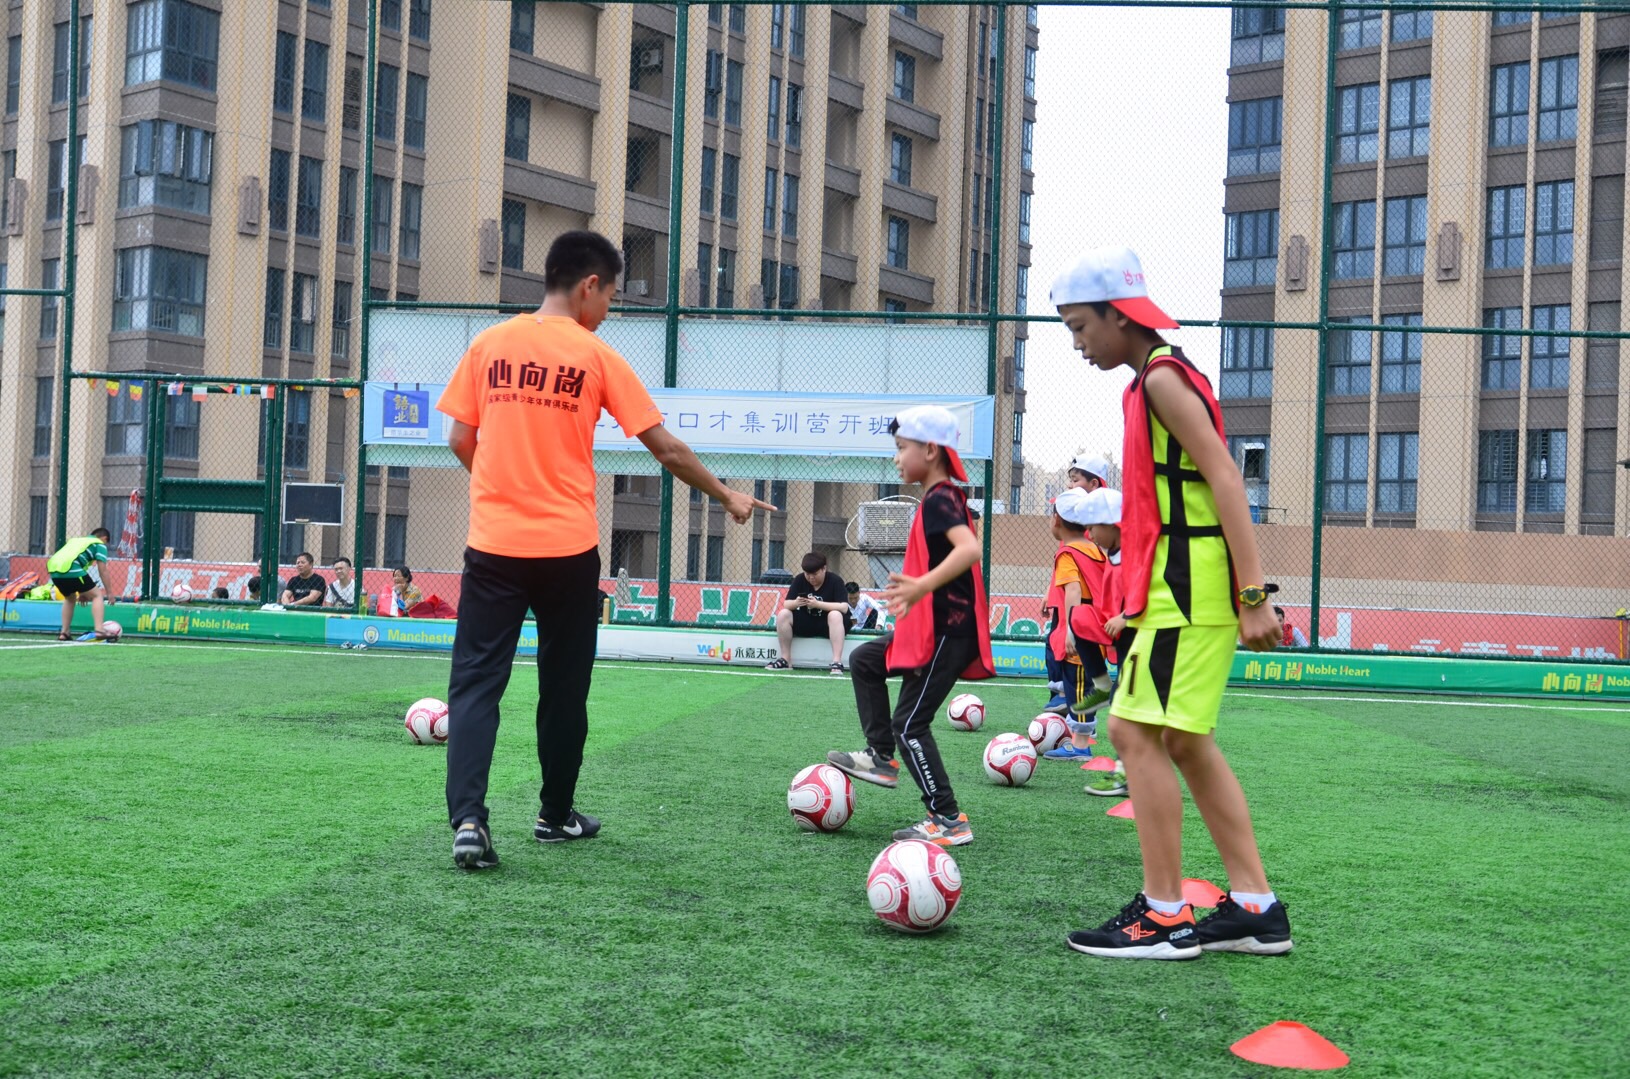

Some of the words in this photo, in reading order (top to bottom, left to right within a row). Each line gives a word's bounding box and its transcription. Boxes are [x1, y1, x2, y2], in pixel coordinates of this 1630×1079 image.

[489, 359, 586, 398] 心向尚
[192, 617, 220, 629] Noble
[222, 619, 250, 630] Heart
[735, 646, 777, 660] 永嘉天地
[1020, 656, 1046, 670] City
[1306, 664, 1338, 675] Noble
[1340, 665, 1370, 677] Heart
[1002, 745, 1030, 755] Rainbow
